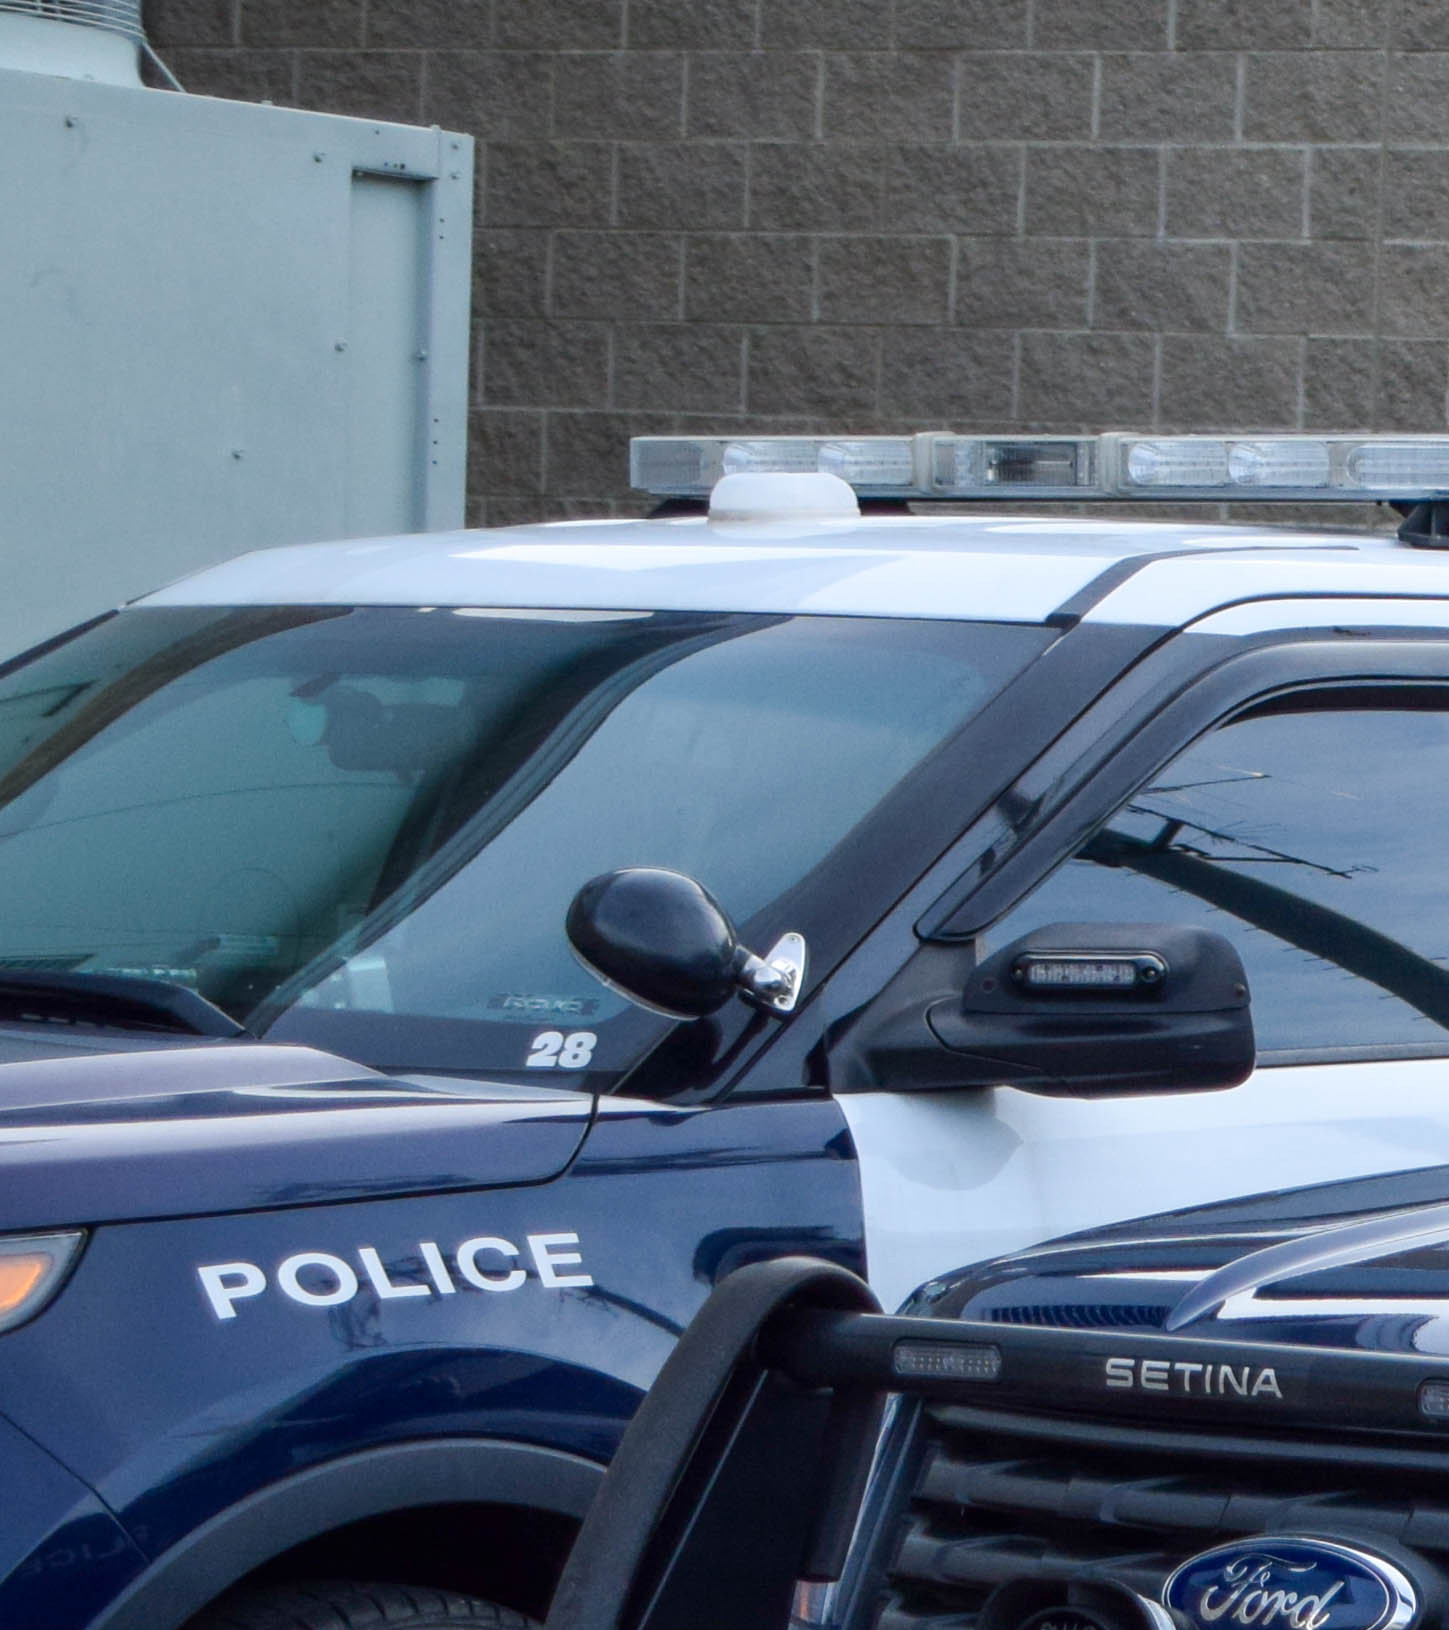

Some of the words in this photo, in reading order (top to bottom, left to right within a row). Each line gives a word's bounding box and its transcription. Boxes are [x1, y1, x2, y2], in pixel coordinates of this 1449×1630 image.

[526, 1030, 598, 1069] 28
[197, 1232, 594, 1320] POLICE
[1105, 1357, 1283, 1399] SETINA
